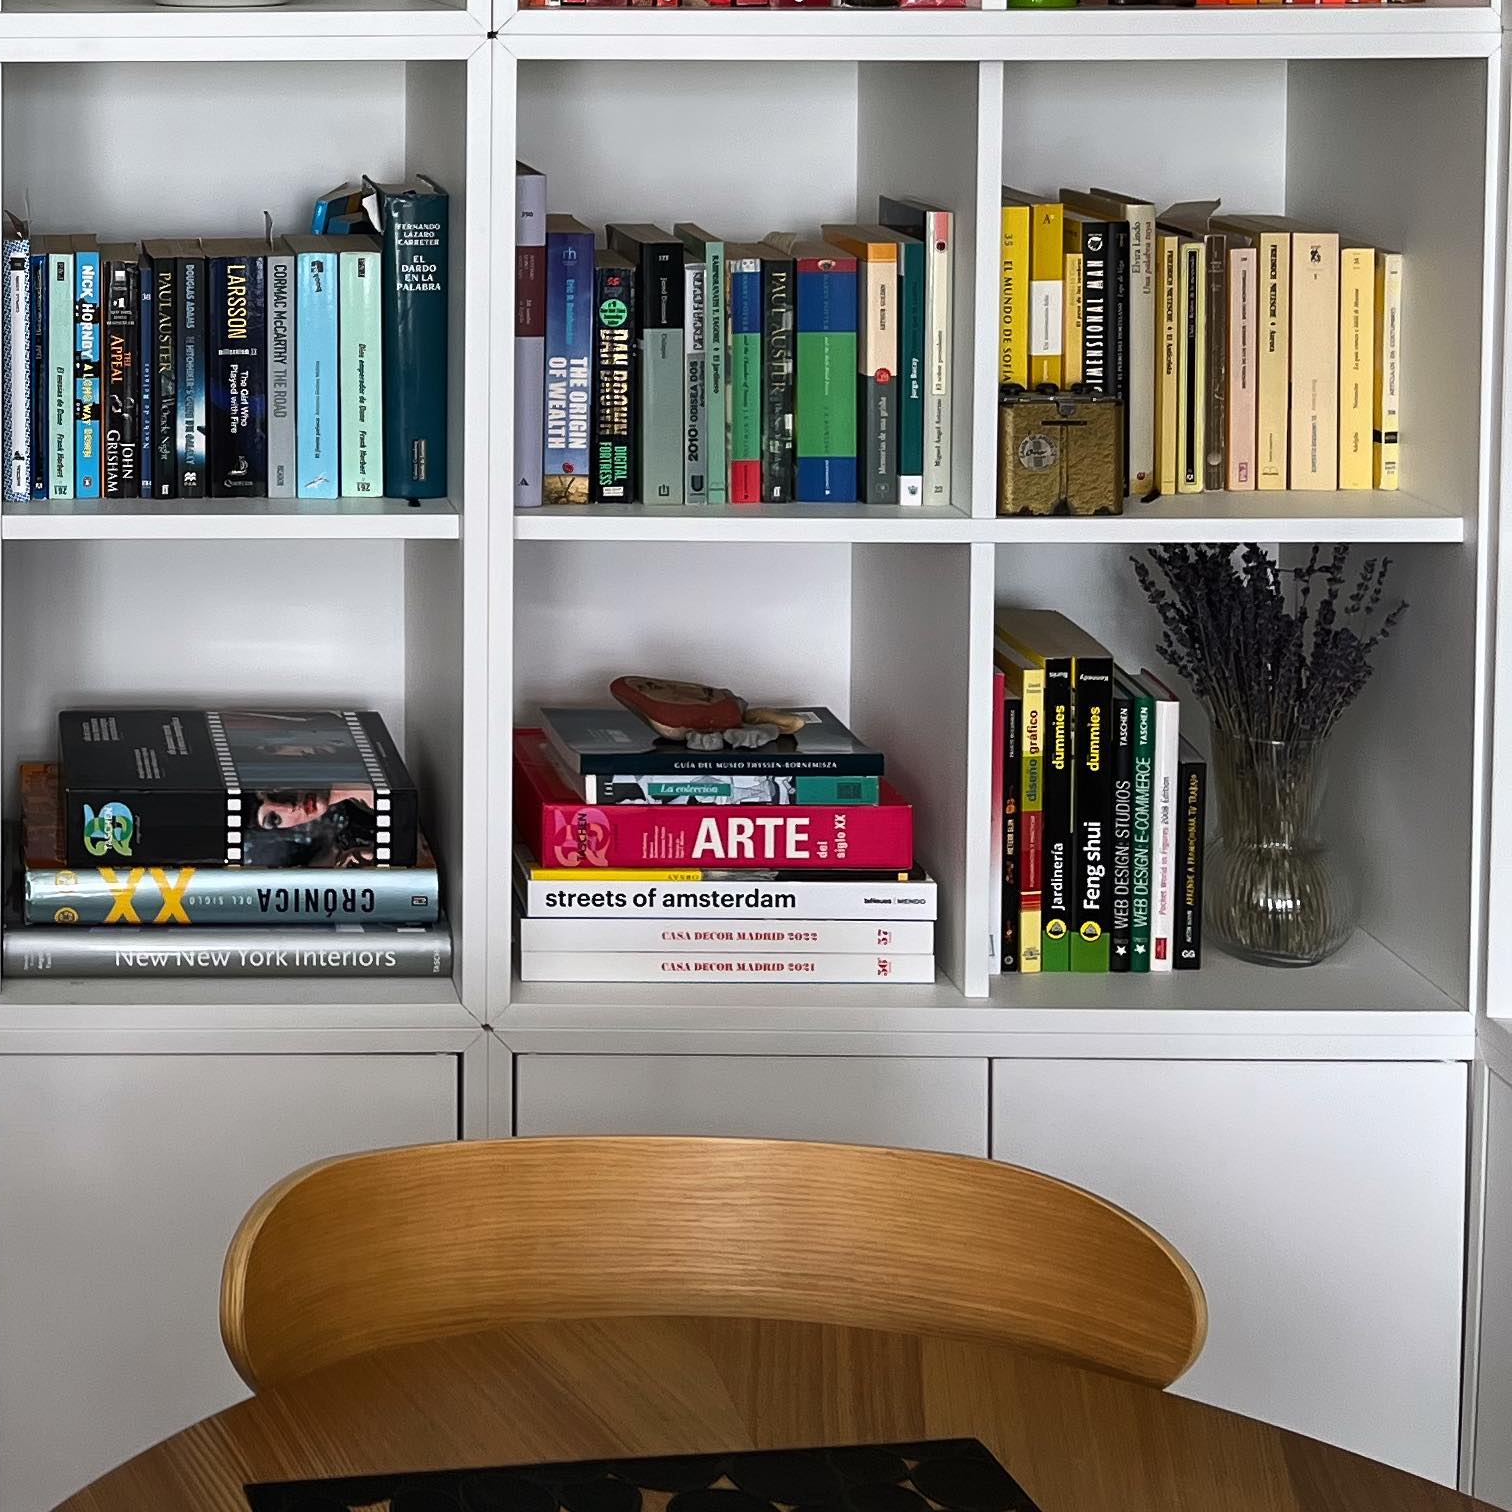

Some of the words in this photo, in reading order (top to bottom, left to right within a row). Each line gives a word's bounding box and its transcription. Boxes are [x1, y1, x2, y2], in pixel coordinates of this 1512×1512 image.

[1130, 221, 1143, 247] Lindo
[400, 264, 437, 273] DARDO
[1085, 259, 1104, 289] MAN
[1130, 247, 1143, 274] Elvira
[226, 264, 247, 339] LARSSON
[395, 282, 442, 291] PALABRA
[548, 356, 566, 381] OF
[569, 356, 587, 386] THE
[547, 383, 566, 449] WEALTH
[567, 391, 587, 450] ORIGIN
[107, 429, 121, 493] GRISHAM
[121, 441, 137, 479] JOHN
[613, 446, 628, 480] DIGITAL
[1051, 704, 1066, 769] dummies
[1086, 706, 1101, 771] dummies
[1118, 707, 1129, 747] TASCHEN
[103, 805, 114, 851] TASCHEN
[1115, 780, 1131, 838] STUDIOS
[690, 816, 811, 860] ARTE
[1082, 821, 1102, 861] shui
[1049, 842, 1066, 911] Jardinería
[1082, 865, 1105, 910] Feng
[1114, 840, 1130, 896] DESIGN:
[97, 866, 196, 925] XX
[188, 896, 225, 905] SIGLO
[231, 896, 253, 905] DEL
[256, 888, 376, 919] CRÓNICA
[544, 888, 628, 909] streets
[631, 888, 658, 909] of
[661, 888, 798, 909] amsterdam
[897, 897, 927, 905] MENDO
[1114, 898, 1129, 929] WEB
[660, 931, 692, 942] CASA
[694, 931, 735, 942] DECOR
[736, 931, 785, 942] MADRID
[787, 931, 819, 942] 2022
[114, 949, 172, 968] New
[175, 948, 233, 968] New
[236, 948, 289, 968] York
[293, 947, 397, 968] Interiors
[660, 962, 692, 973] CASA
[694, 962, 735, 973] DECOR
[736, 962, 785, 973] MADRID
[787, 962, 816, 973] 2021
